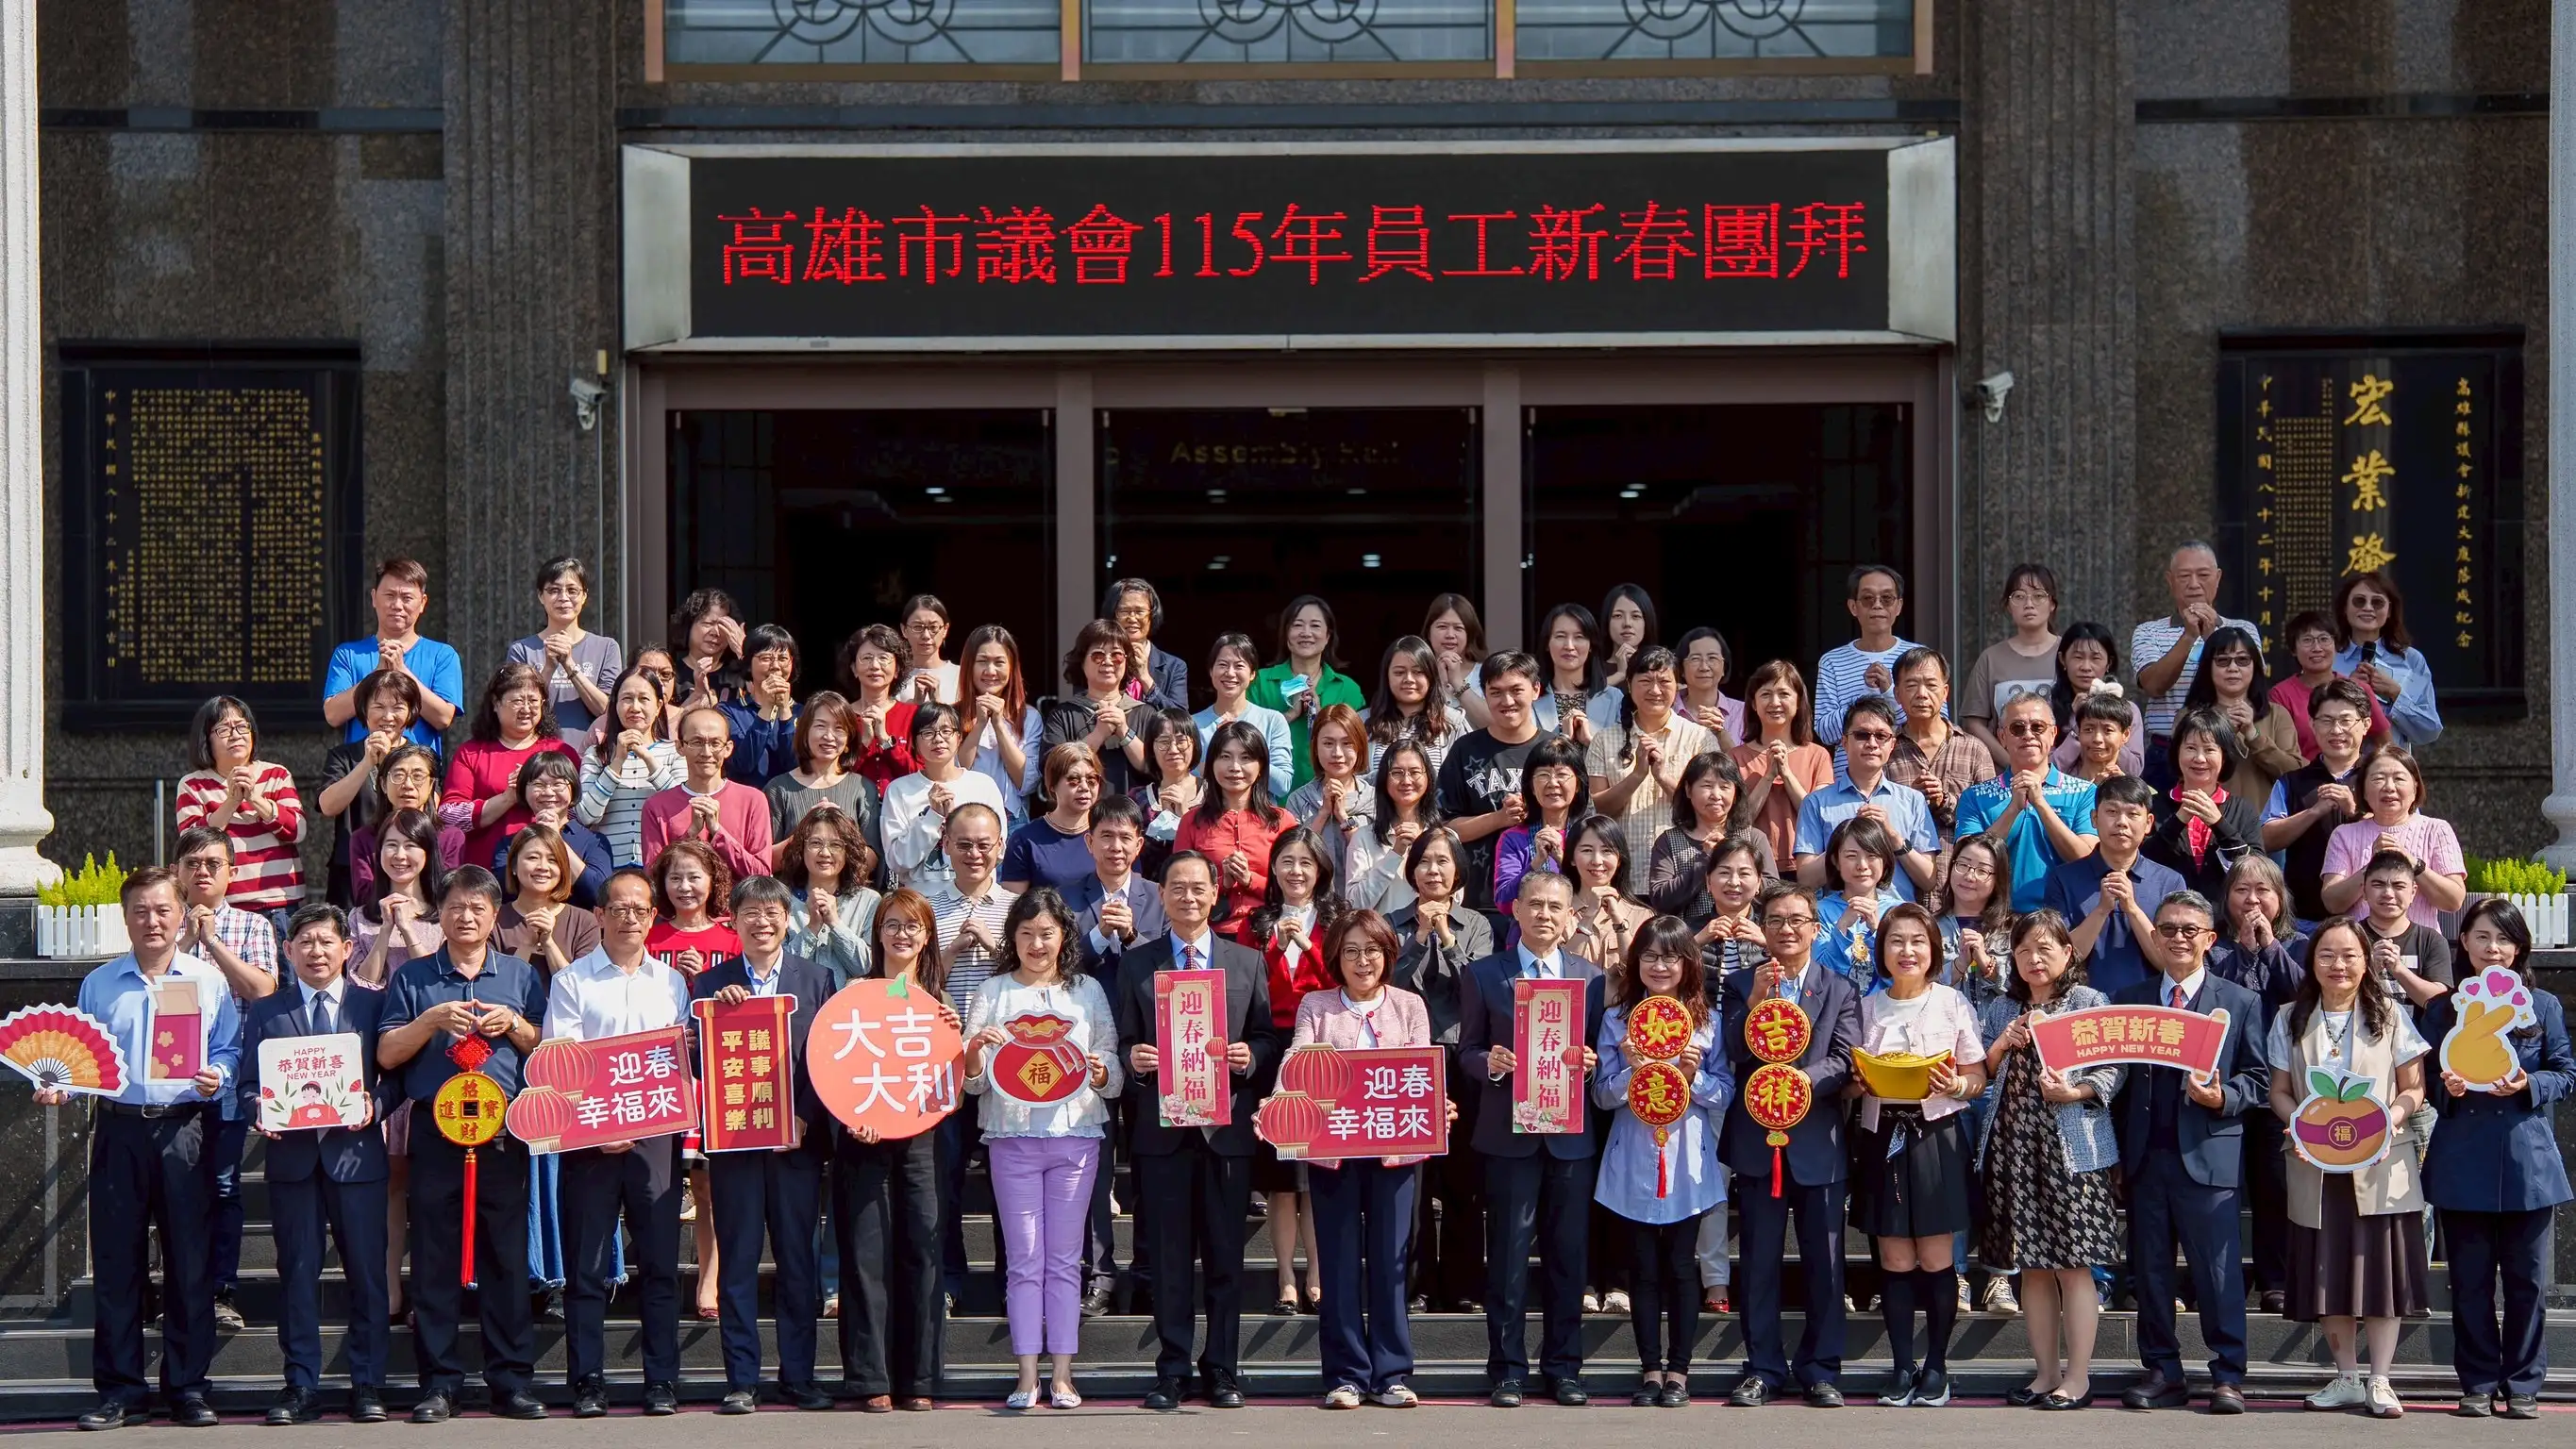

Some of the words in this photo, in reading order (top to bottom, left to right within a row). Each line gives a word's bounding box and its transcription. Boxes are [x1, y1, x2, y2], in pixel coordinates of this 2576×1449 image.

[717, 201, 1866, 286] 高雄市議會115年員工新春團拜
[293, 1046, 326, 1057] HAPPY
[831, 1006, 935, 1060] 大吉
[1179, 991, 1207, 1101] 迎春納福
[2070, 1015, 2185, 1046] 恭賀新春
[2076, 1044, 2116, 1058] HAPPY
[2120, 1043, 2145, 1053] NEW
[2149, 1044, 2182, 1057] YEAR
[277, 1054, 344, 1074] 恭賀新喜
[286, 1072, 309, 1080] NEW
[310, 1070, 337, 1078] YEAR
[609, 1044, 678, 1087] 迎春
[1029, 1063, 1051, 1086] 福
[1536, 1000, 1563, 1108] 迎春納福
[1637, 1008, 1684, 1114] 如意
[1757, 1008, 1797, 1121] 吉祥
[721, 1030, 746, 1132] 平安喜樂
[748, 1029, 774, 1130] 議事順利
[852, 1059, 956, 1115] 大利
[1363, 1063, 1433, 1100] 迎春
[577, 1084, 682, 1129] 幸福來
[1328, 1104, 1432, 1141] 幸福來
[2333, 1124, 2351, 1141] 福
